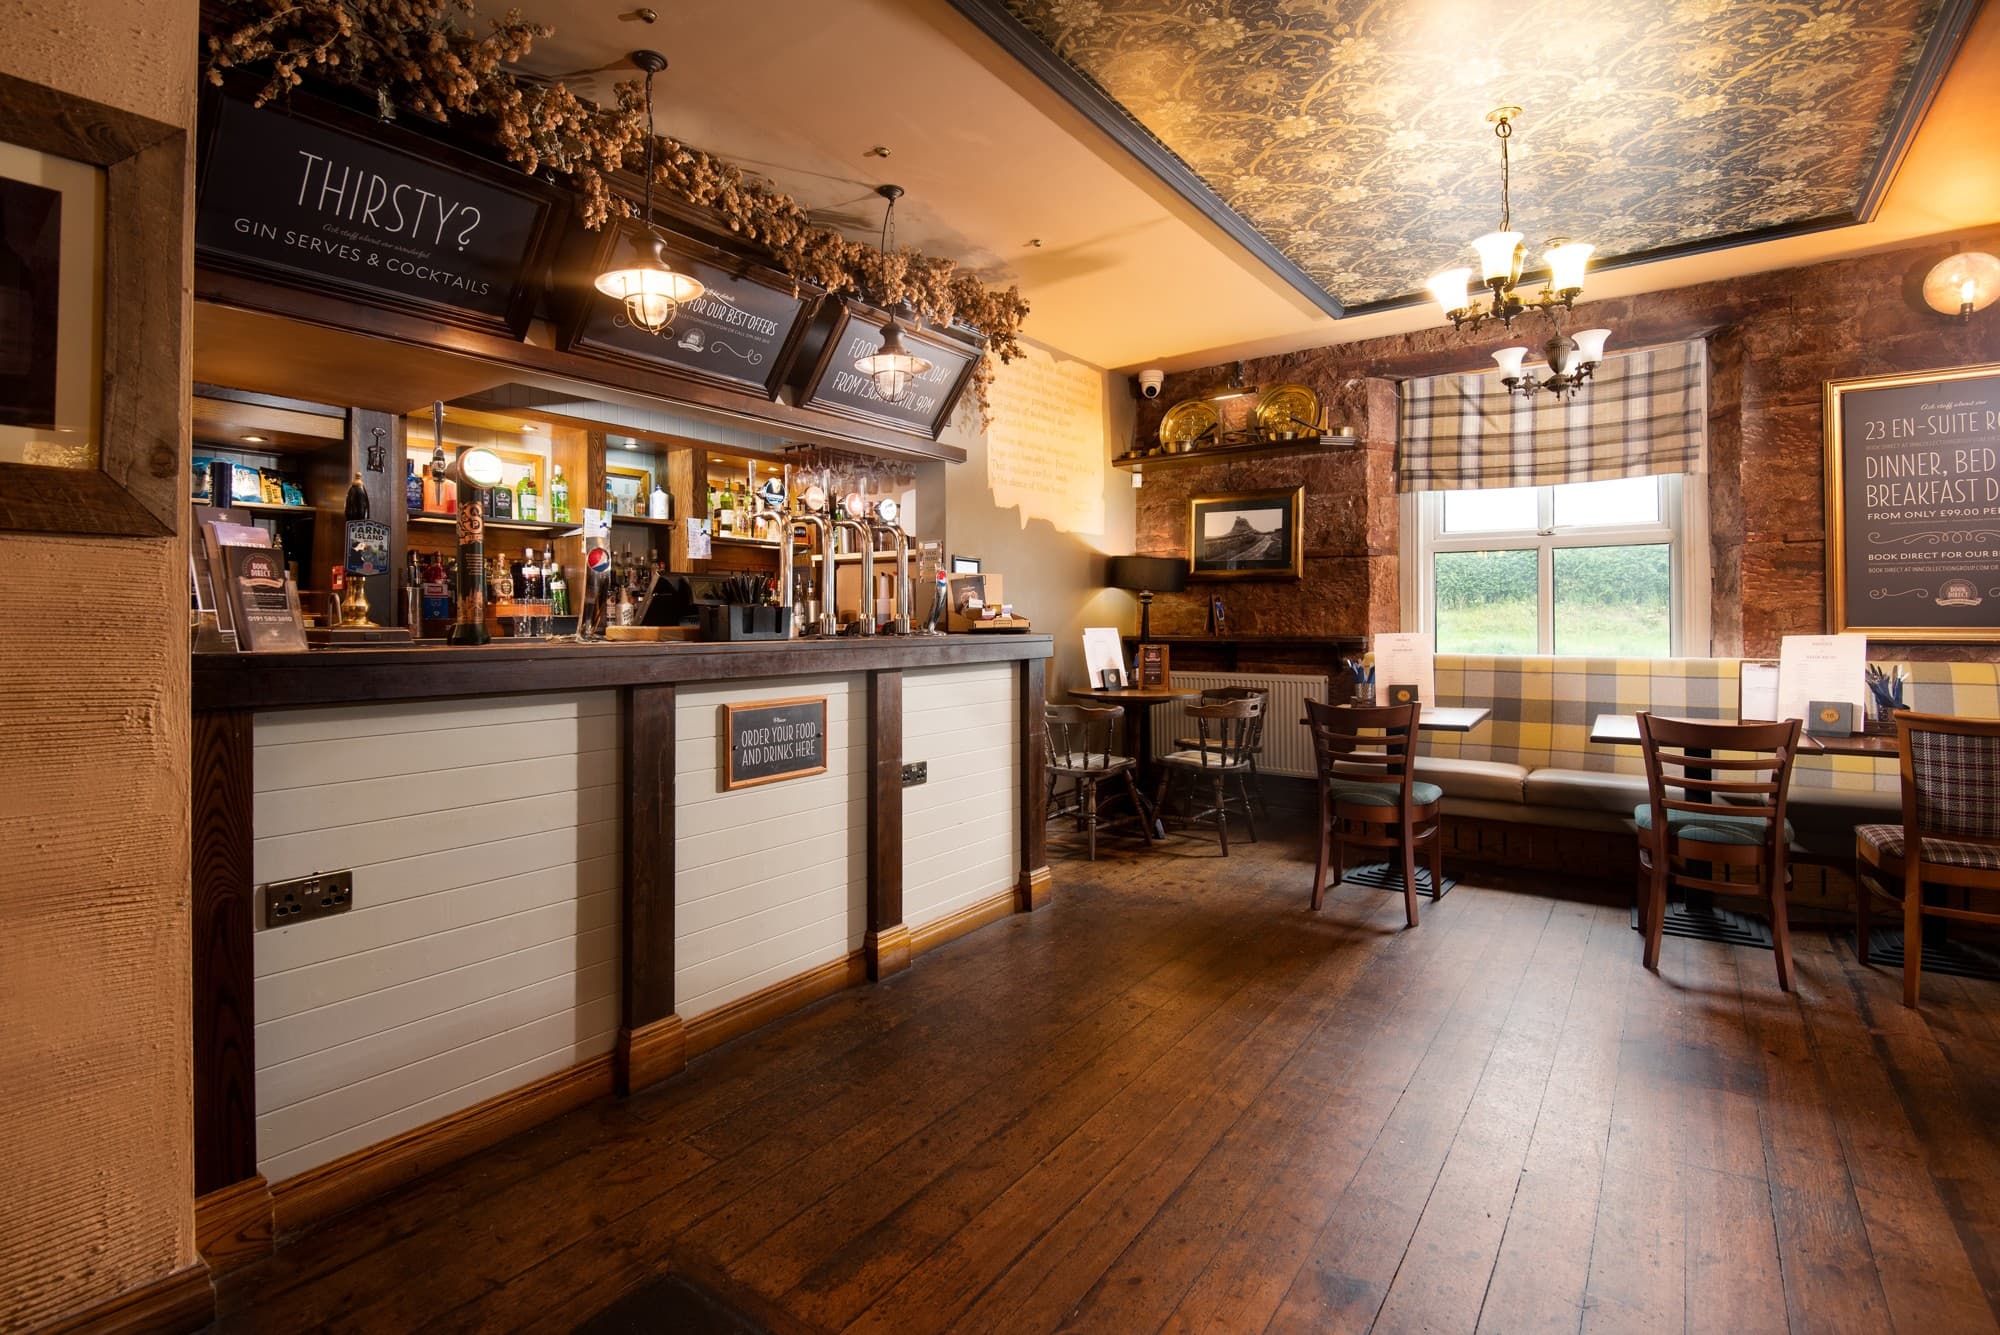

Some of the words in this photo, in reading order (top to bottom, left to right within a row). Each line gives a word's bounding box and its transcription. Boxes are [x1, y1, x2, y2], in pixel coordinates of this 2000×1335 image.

[298, 150, 481, 252] THIRSTY?
[234, 217, 278, 241] GIN
[284, 230, 361, 262] SERVES
[366, 253, 380, 267] &
[386, 257, 490, 296] COCKTAILS
[706, 302, 728, 321] OUR
[725, 308, 751, 331] BEST
[747, 315, 779, 337] OFFERS
[929, 366, 952, 385] DAY
[831, 371, 861, 396] FROM
[913, 395, 936, 415] 9PM
[1865, 420, 1886, 441] 23
[1892, 411, 1980, 439] EN-SUITE
[1985, 410, 2000, 431] R
[1866, 451, 1948, 479] DINNER,
[1955, 447, 1997, 474] BED
[1866, 478, 1980, 508] BREAKFAST
[1867, 511, 1901, 521] FROM
[1904, 510, 1937, 519] ONLY
[1940, 507, 1980, 518] £99.00
[351, 526, 386, 536] FARNE
[354, 532, 384, 541] ISLAND
[252, 562, 268, 570] BOOK
[1868, 553, 1898, 561] BOOK
[1900, 551, 1938, 560] DIRECT
[1941, 550, 1962, 559] FOR
[1964, 550, 1989, 558] OUR
[250, 569, 271, 577] DIRECT
[741, 727, 770, 748] ORDER
[771, 724, 794, 743] YOUR
[795, 721, 816, 740] FOOD
[741, 747, 762, 767] AND
[763, 742, 794, 764] DRINKS
[795, 739, 816, 758] HERE
